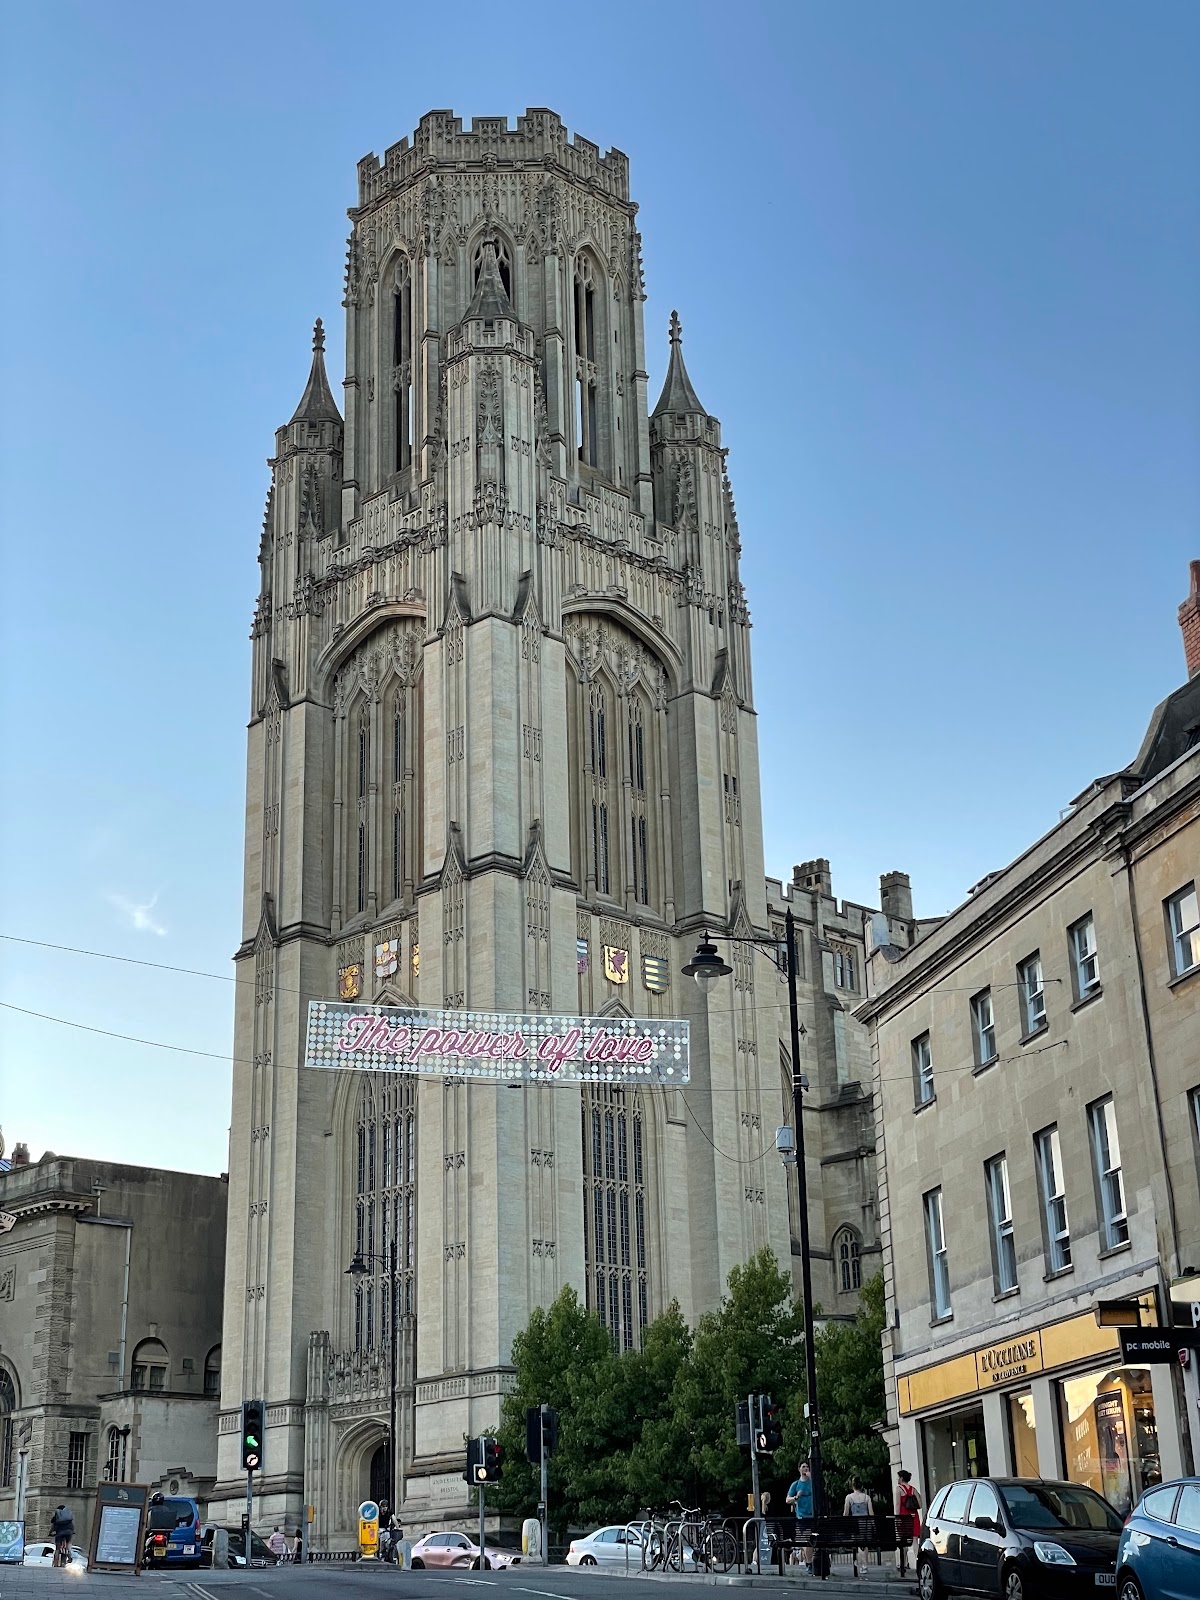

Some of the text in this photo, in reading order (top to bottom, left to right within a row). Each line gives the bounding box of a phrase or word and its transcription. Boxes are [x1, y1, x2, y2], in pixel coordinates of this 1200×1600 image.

[339, 1014, 654, 1073] The power of love
[981, 1339, 1036, 1372] L'OCCITANE
[1126, 1340, 1170, 1352] pc mobile
